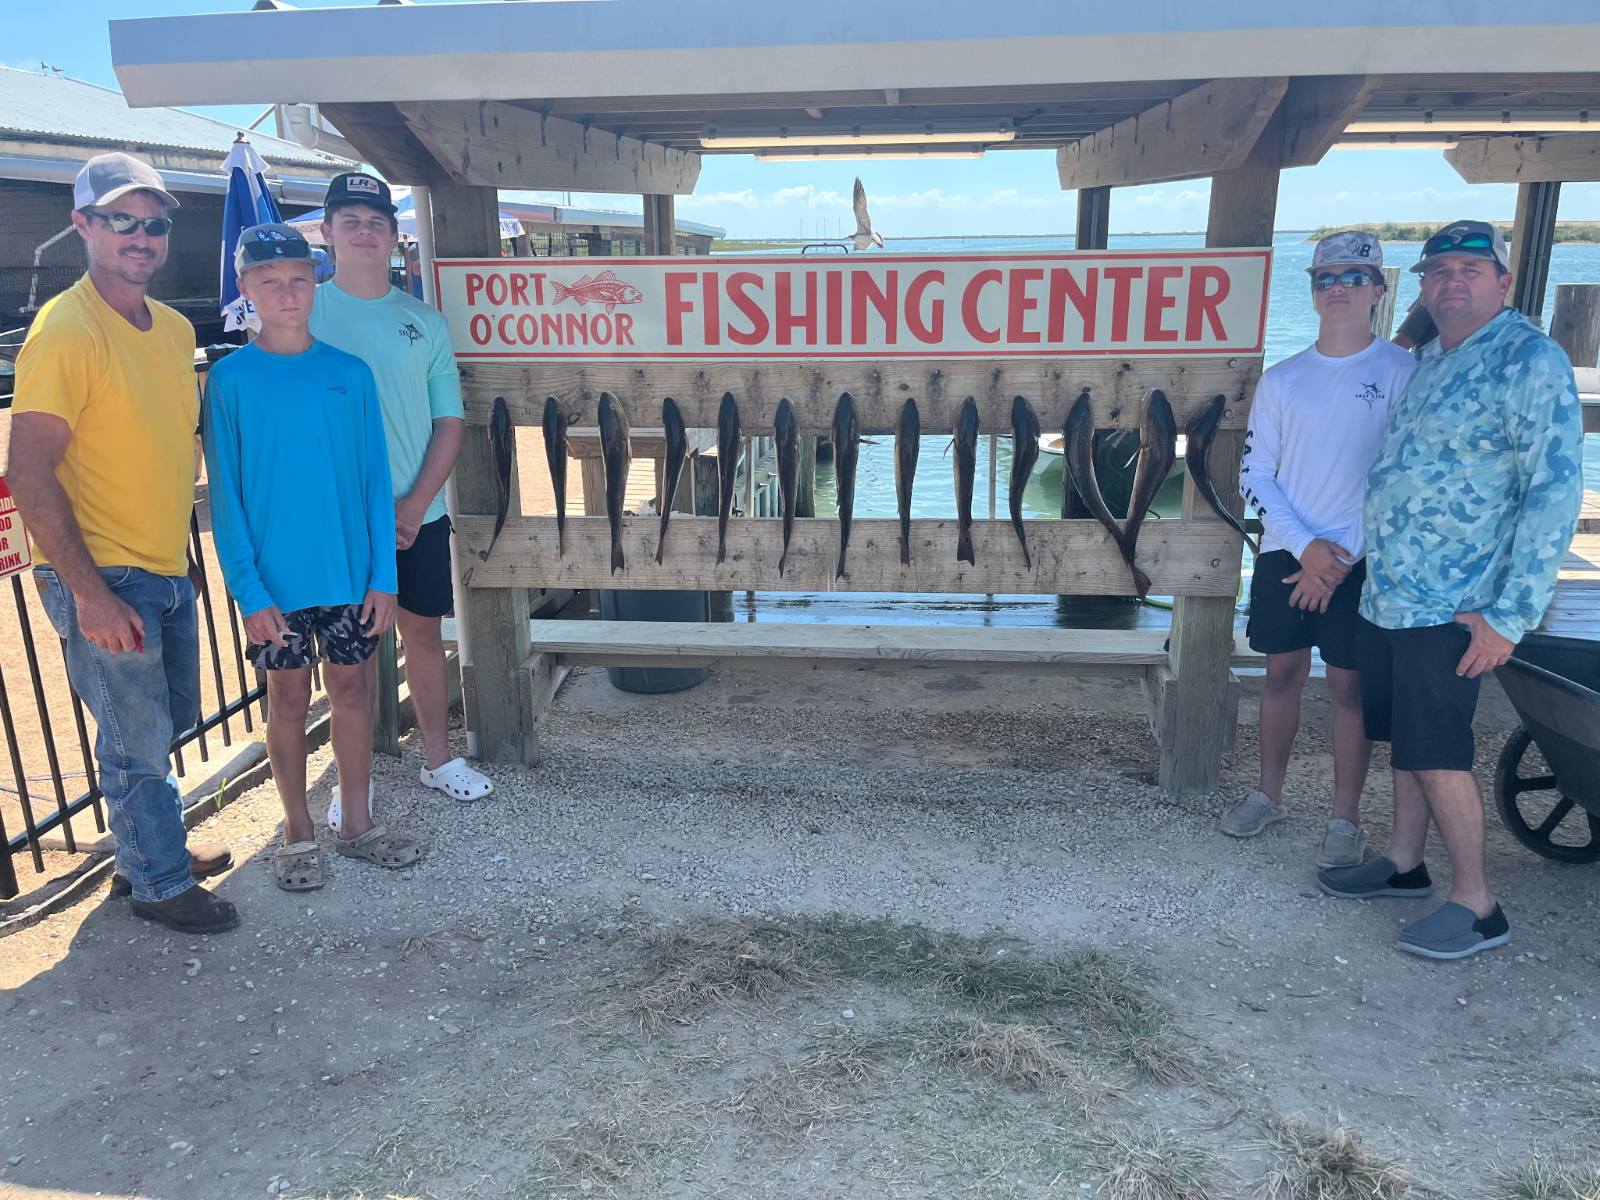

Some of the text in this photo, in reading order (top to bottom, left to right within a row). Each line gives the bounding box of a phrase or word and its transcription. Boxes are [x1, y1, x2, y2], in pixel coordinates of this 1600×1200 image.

[465, 272, 547, 306] PORT
[664, 265, 1231, 346] FISHING CENTER
[470, 313, 635, 346] O'CONNOR
[0, 537, 9, 552] R
